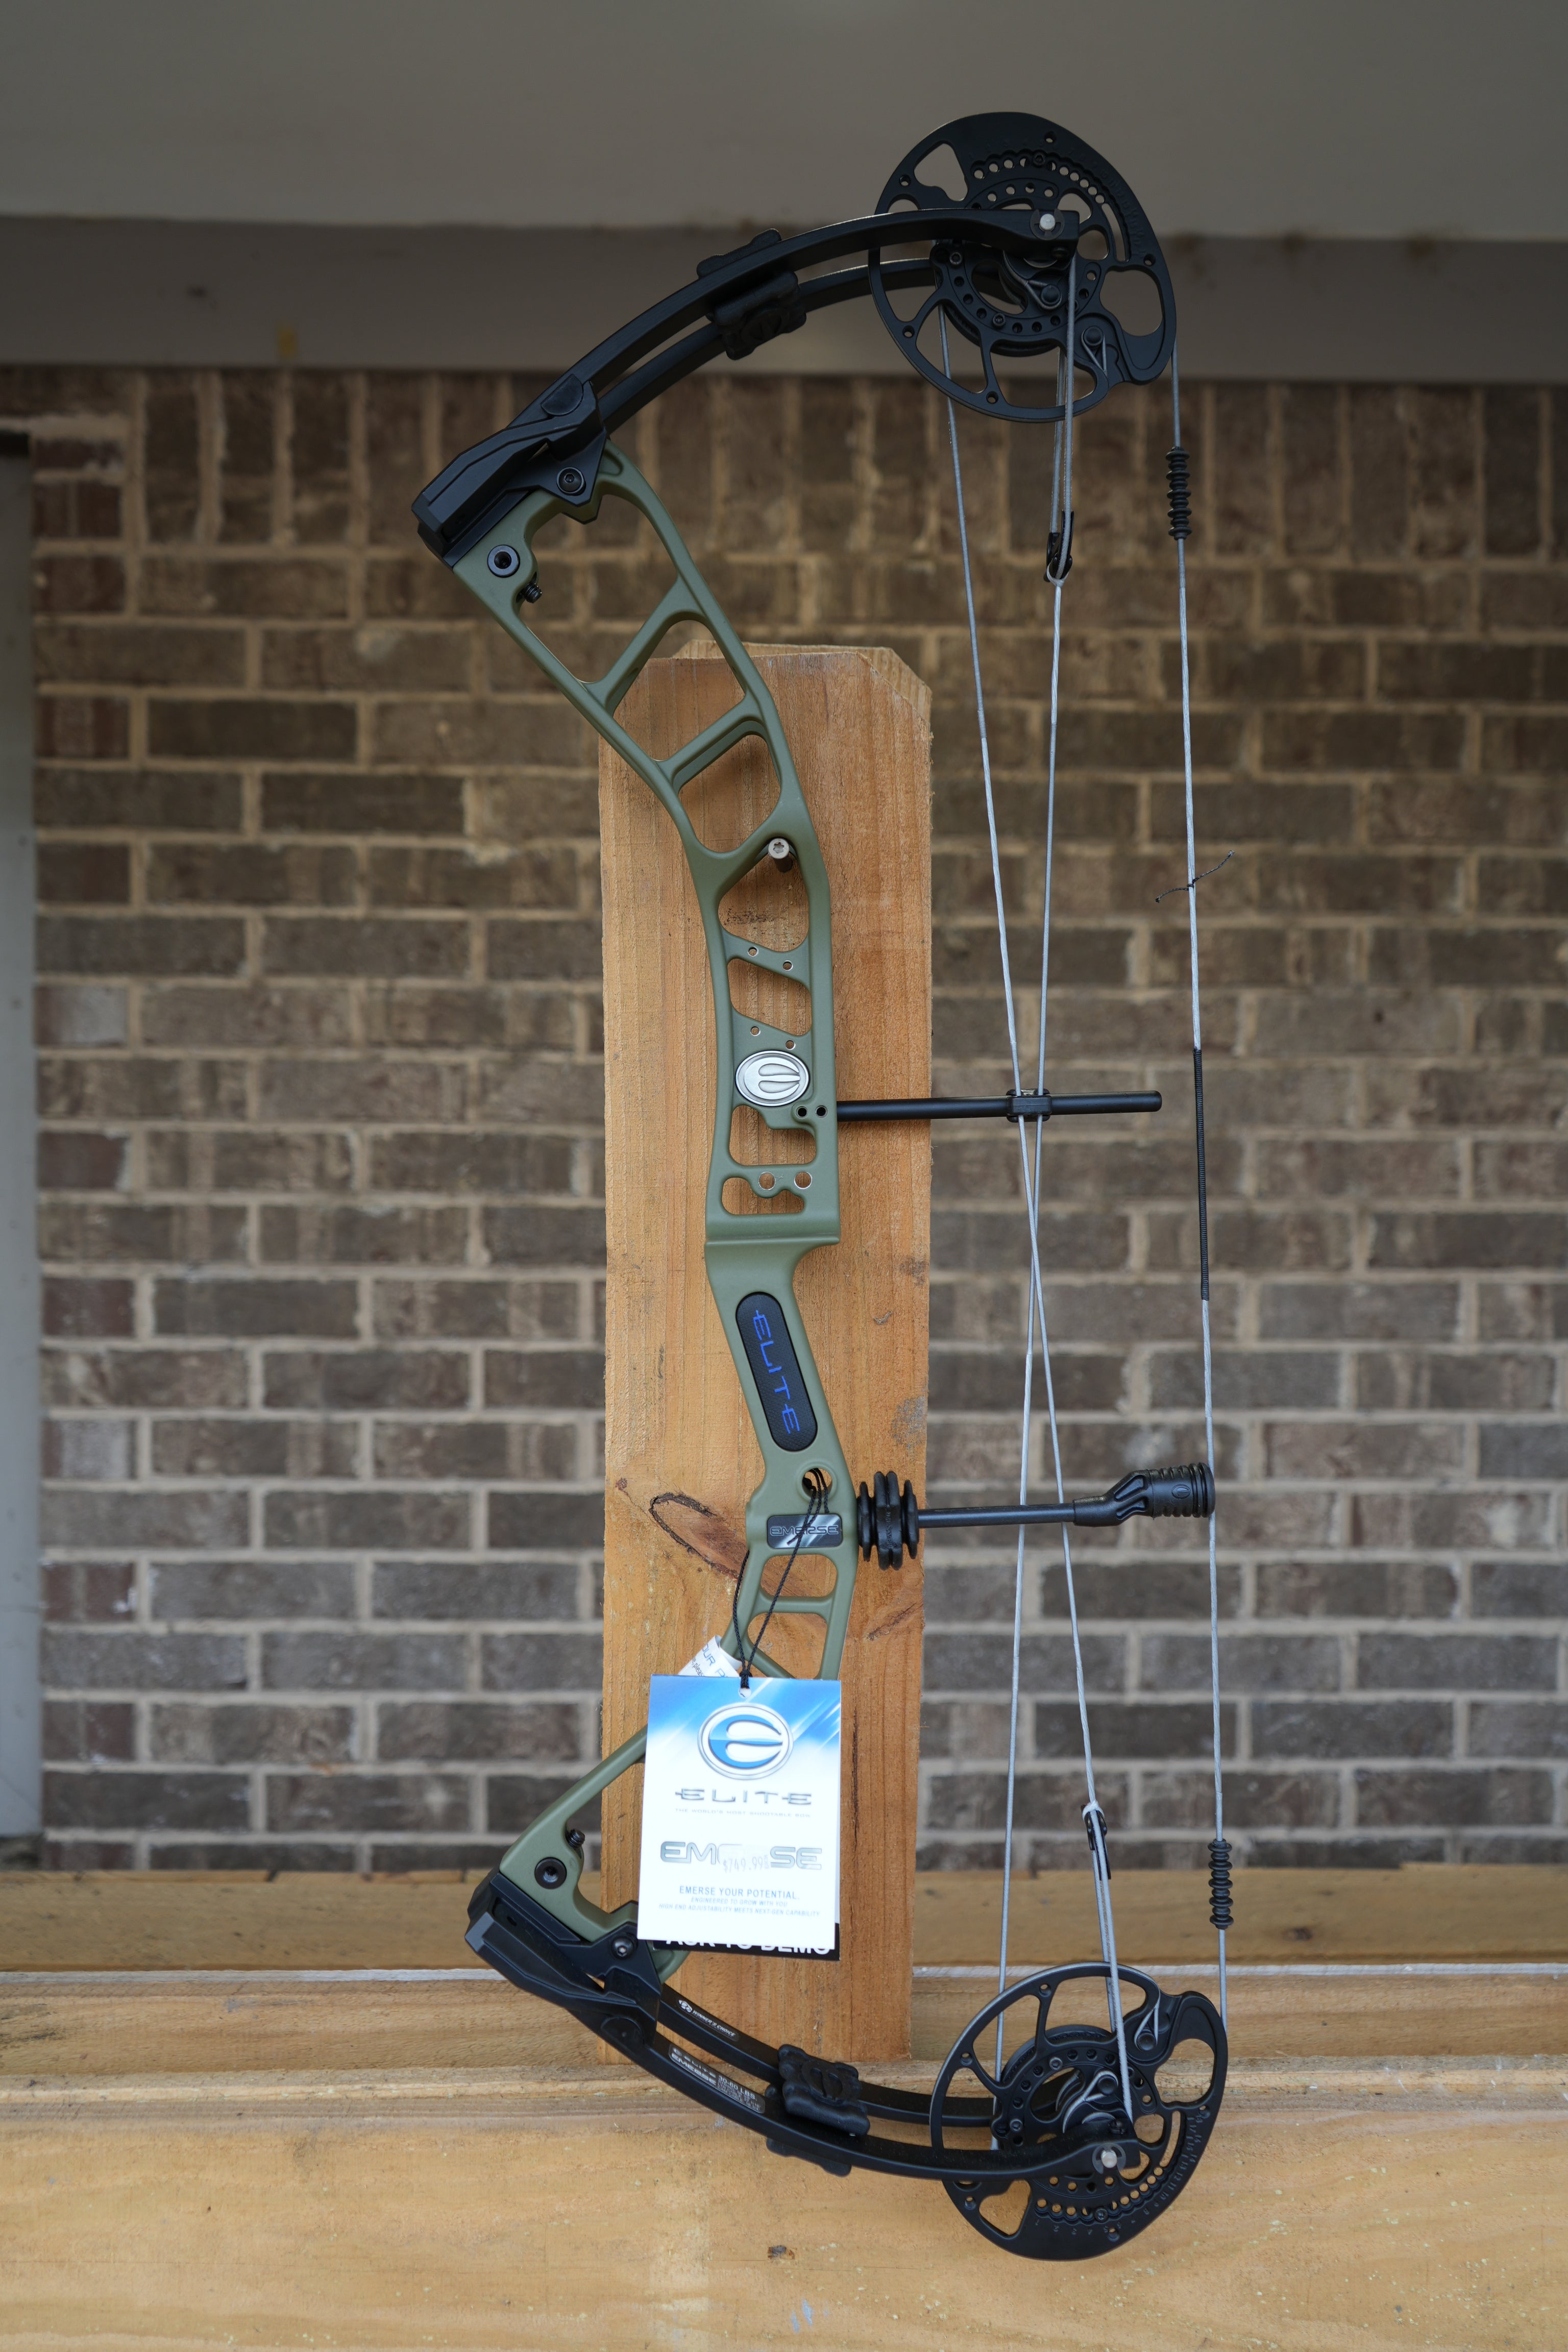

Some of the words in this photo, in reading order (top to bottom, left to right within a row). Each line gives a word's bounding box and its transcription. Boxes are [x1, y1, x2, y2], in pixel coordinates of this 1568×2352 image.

[752, 1309, 801, 1435] ELITE
[675, 1787, 812, 1806] ELITE
[660, 1841, 823, 1871] EMSE
[723, 1856, 763, 1873] $749.99
[679, 1885, 716, 1896] EMERSE
[719, 1887, 744, 1897] YOUR
[747, 1889, 800, 1900] POTENTIAL.
[689, 1904, 732, 1913] ADJUSTABILITY
[692, 2010, 717, 2027] WINNER'S
[717, 2025, 736, 2037] CHOICE
